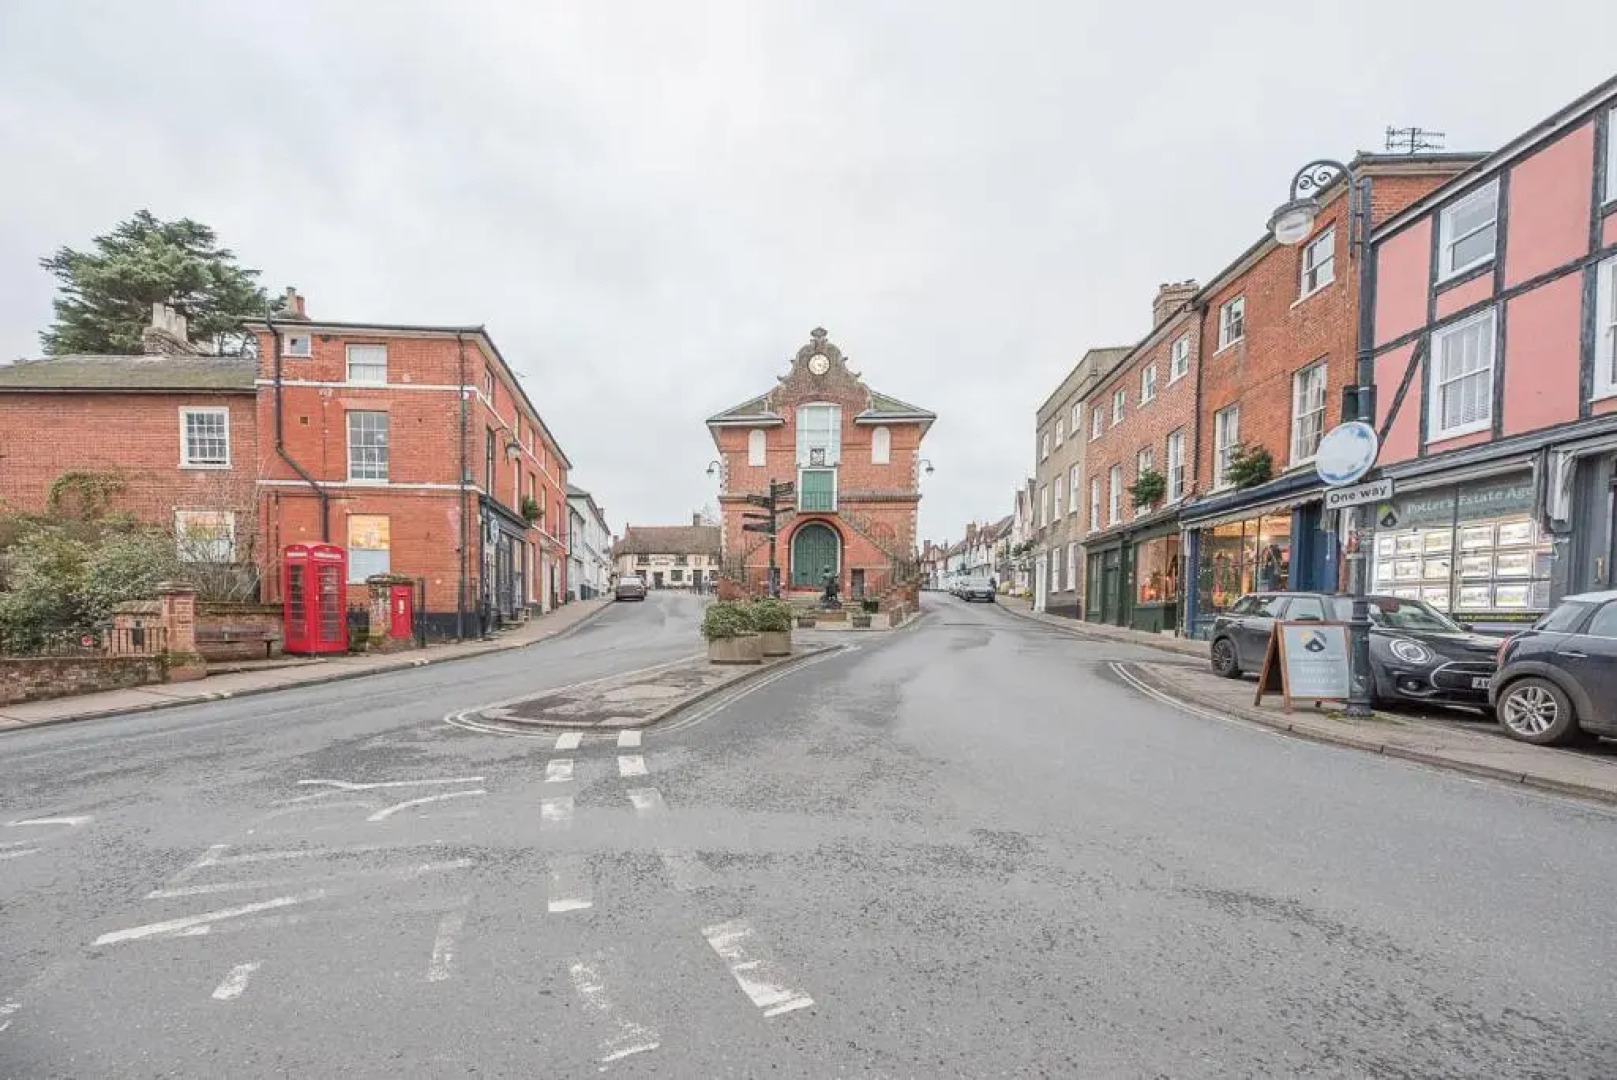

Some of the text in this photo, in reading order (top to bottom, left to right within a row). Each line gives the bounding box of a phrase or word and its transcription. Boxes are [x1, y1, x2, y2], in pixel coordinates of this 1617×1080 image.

[1330, 485, 1387, 503] One way
[1458, 490, 1500, 506] Estate
